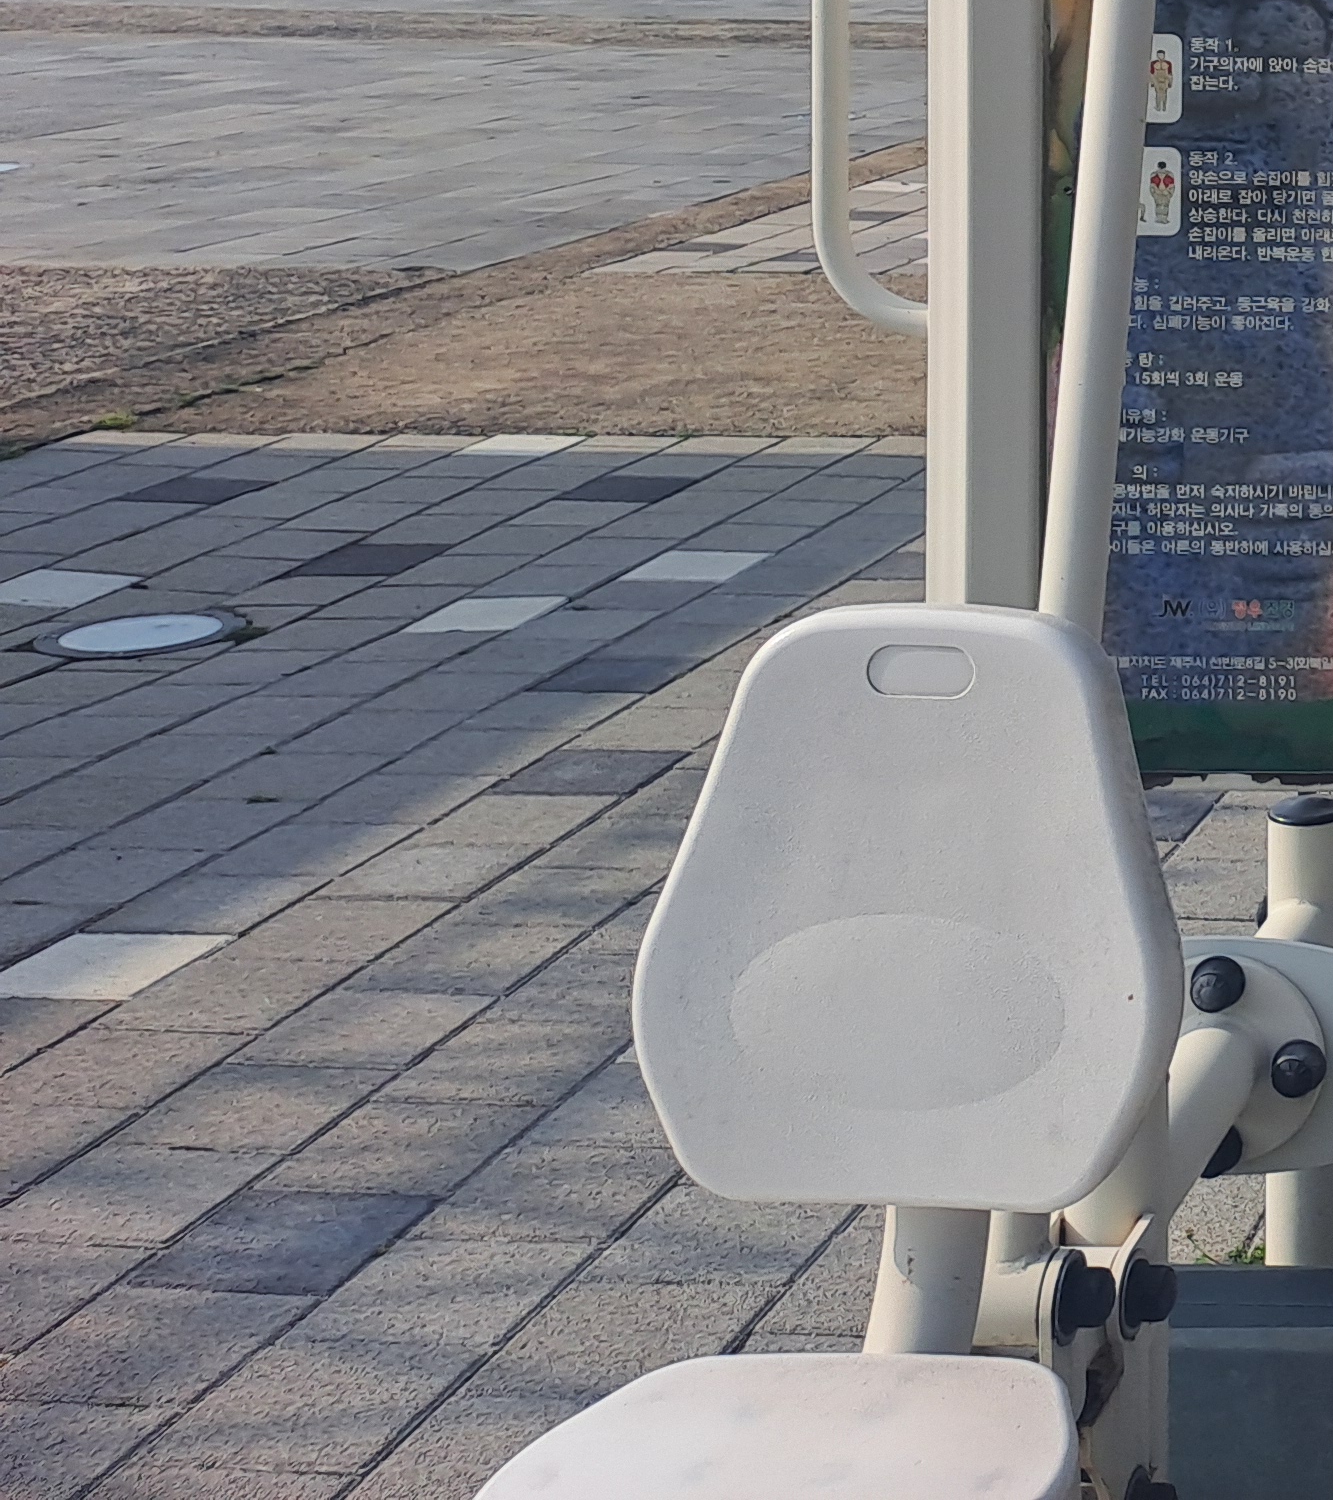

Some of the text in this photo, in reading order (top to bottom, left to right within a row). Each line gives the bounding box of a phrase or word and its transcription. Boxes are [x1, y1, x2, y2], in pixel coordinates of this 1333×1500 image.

[1190, 37, 1219, 53] 동작
[1189, 56, 1263, 73] 기구의자에
[1269, 57, 1298, 73] 앉아
[1189, 75, 1239, 92] 잡는다.
[1188, 151, 1238, 167] 동작 2.
[1188, 169, 1247, 186] 양손으로
[1188, 189, 1234, 205] 아래로
[1238, 190, 1267, 205] 잡아
[1273, 190, 1316, 206] 당기면
[1188, 207, 1252, 224] 상승한다.
[1257, 208, 1286, 224] 다시
[1214, 371, 1244, 388] 운동
[1190, 428, 1250, 444] 운동기구
[1176, 484, 1204, 499] 먼저
[1210, 484, 1283, 500] 숙지하시기
[1210, 504, 1254, 519] 의사나
[1110, 541, 1155, 556] 이들은
